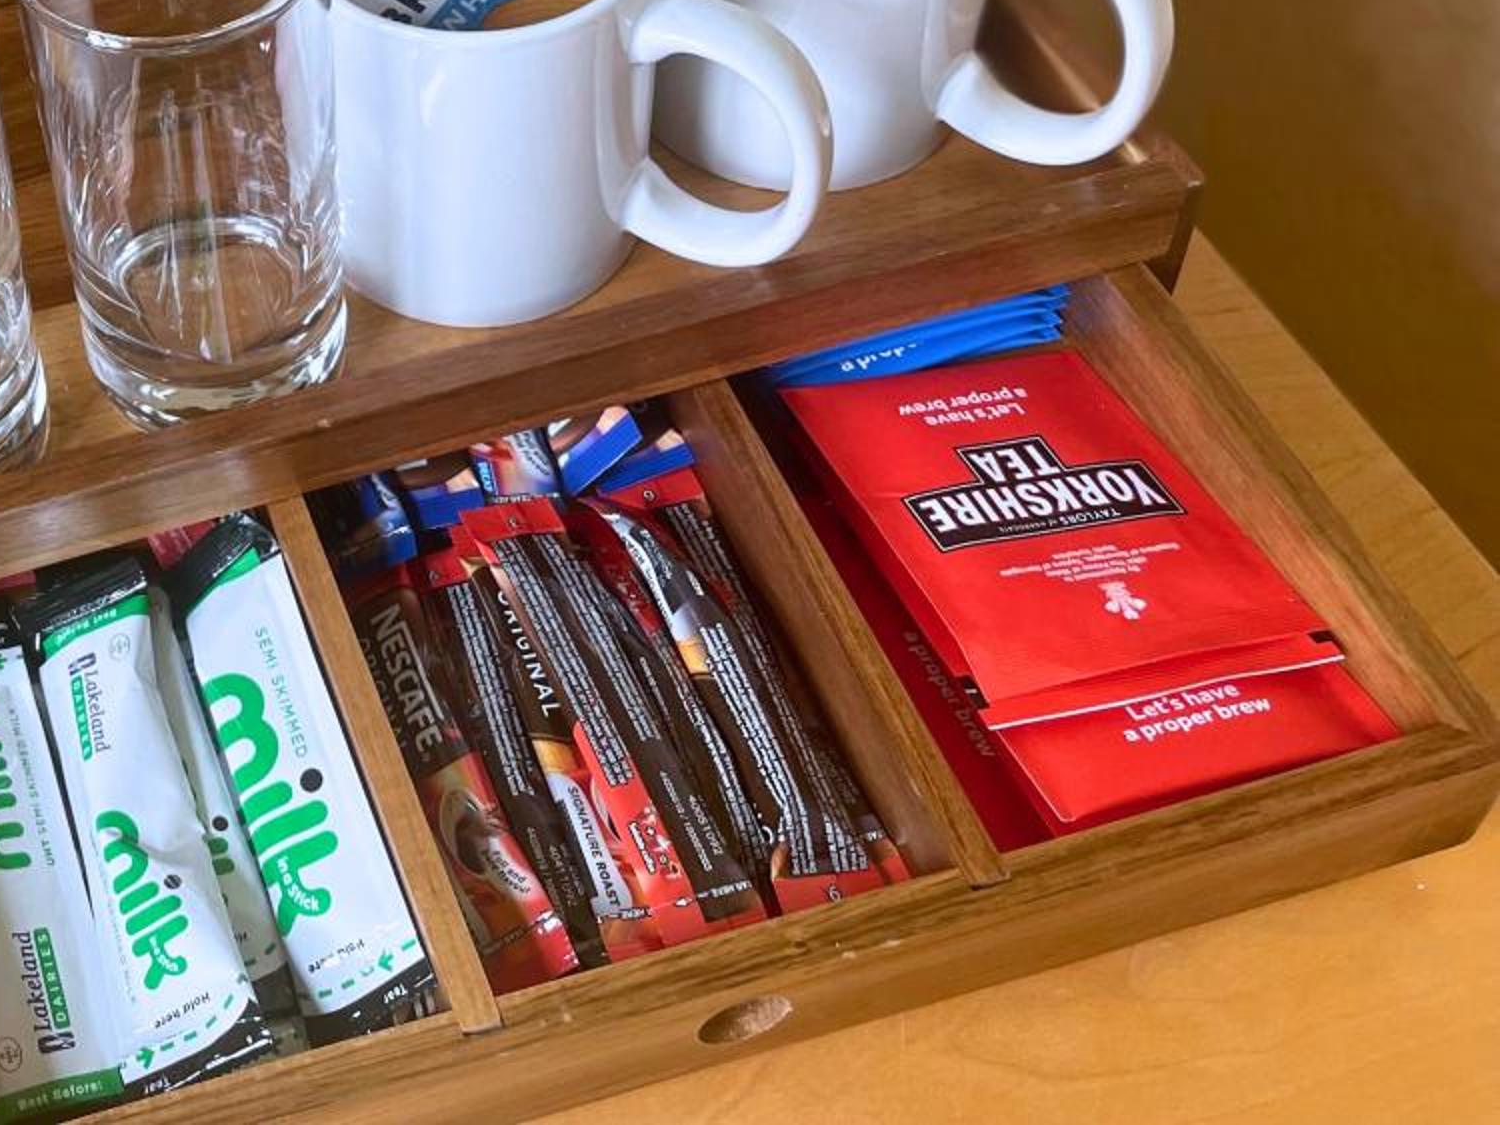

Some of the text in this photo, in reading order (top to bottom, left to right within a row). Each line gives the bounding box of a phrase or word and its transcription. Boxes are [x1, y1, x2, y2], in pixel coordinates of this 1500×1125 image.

[898, 397, 949, 416] brew
[925, 401, 1026, 426] Let's have
[950, 386, 1013, 410] proper
[967, 444, 1062, 483] TEA
[918, 468, 1168, 533] YORKSHIRE
[1058, 507, 1122, 525] TAYLORS
[84, 670, 112, 753] Lakeland
[254, 626, 308, 759] SEMI SKIMMED
[909, 645, 957, 707] proper
[955, 705, 997, 758] brew
[1123, 695, 1272, 743] a proper brew
[1125, 681, 1242, 722] Let's have
[203, 672, 339, 937] milk
[566, 784, 621, 907] SIGNATURE ROAST
[95, 810, 189, 990] milk
[12, 931, 53, 1032] Lakeland
[37, 933, 68, 1023] DAIRIES
[154, 991, 211, 1029] Hold here
[16, 1095, 50, 1112] Best
